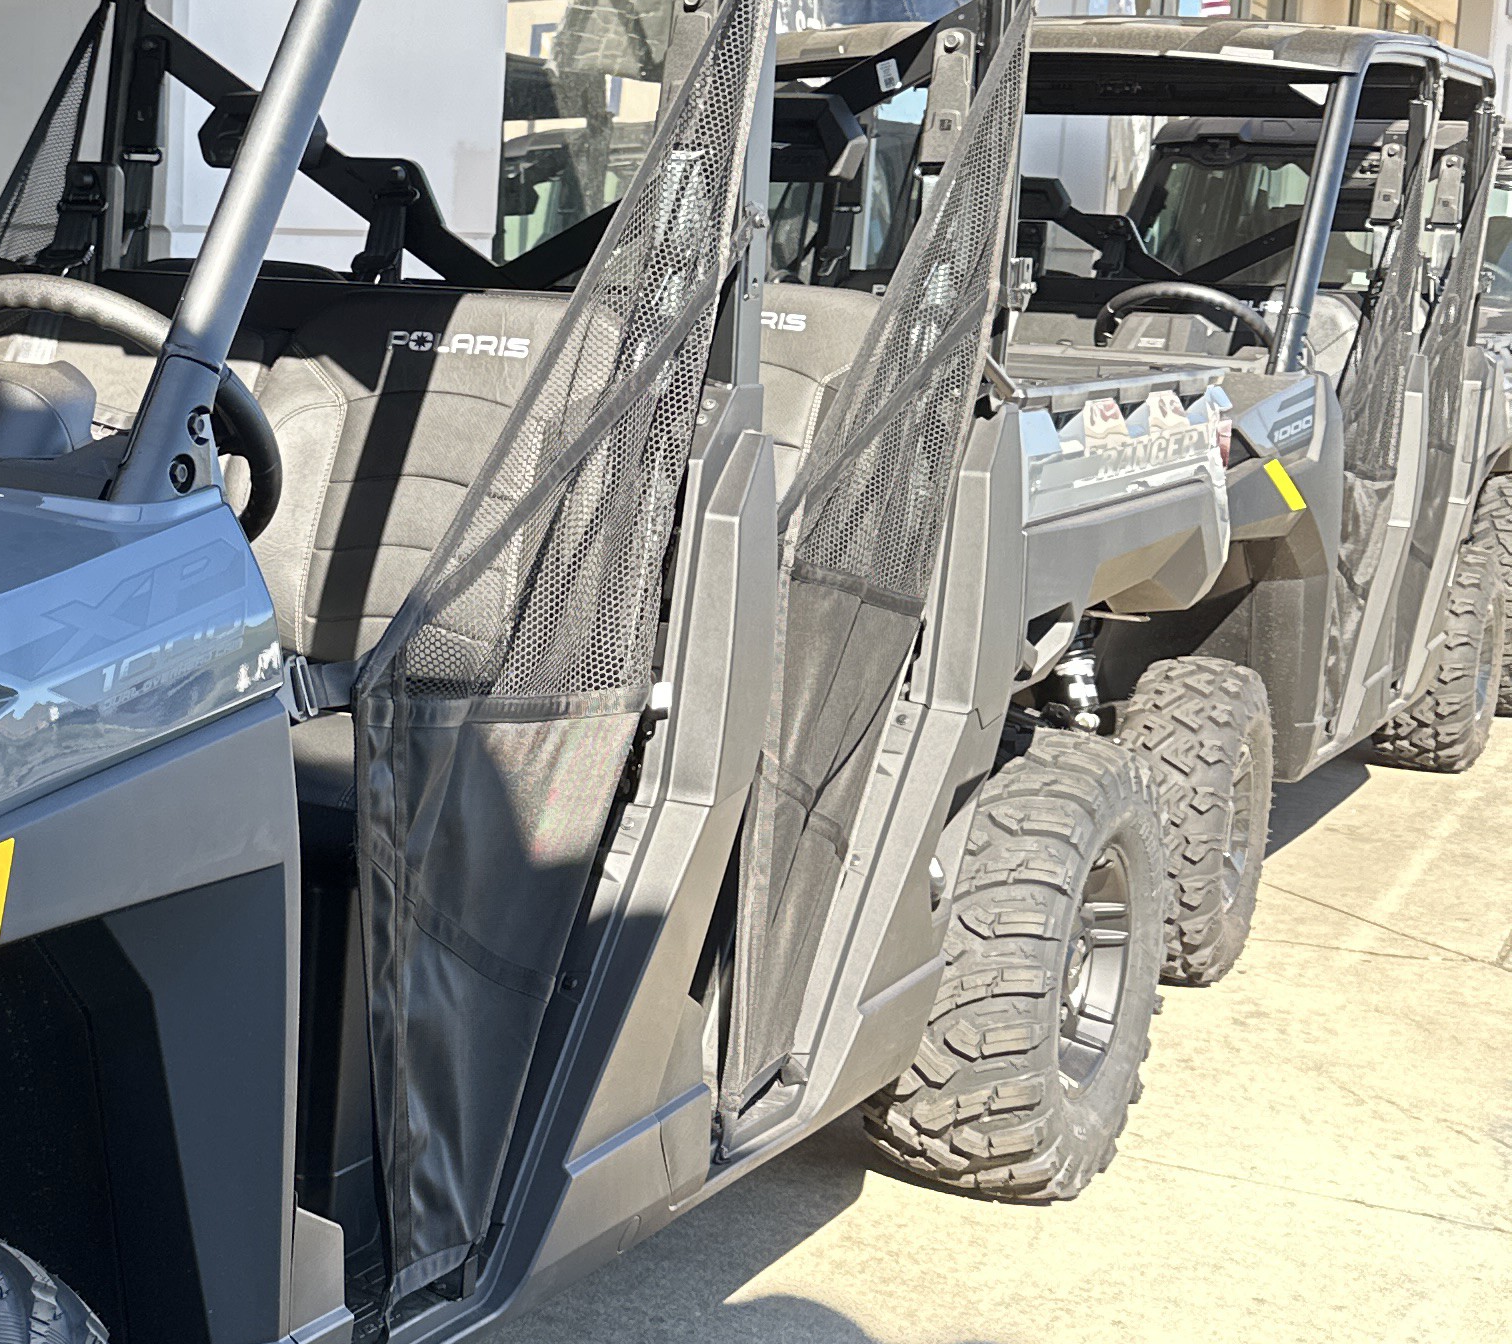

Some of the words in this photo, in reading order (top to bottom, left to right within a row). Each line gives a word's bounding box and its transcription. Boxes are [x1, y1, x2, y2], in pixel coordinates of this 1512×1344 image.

[760, 311, 807, 332] RIS
[387, 330, 531, 359] POLARIS
[1273, 415, 1313, 443] 1000
[1097, 428, 1210, 479] RANGER
